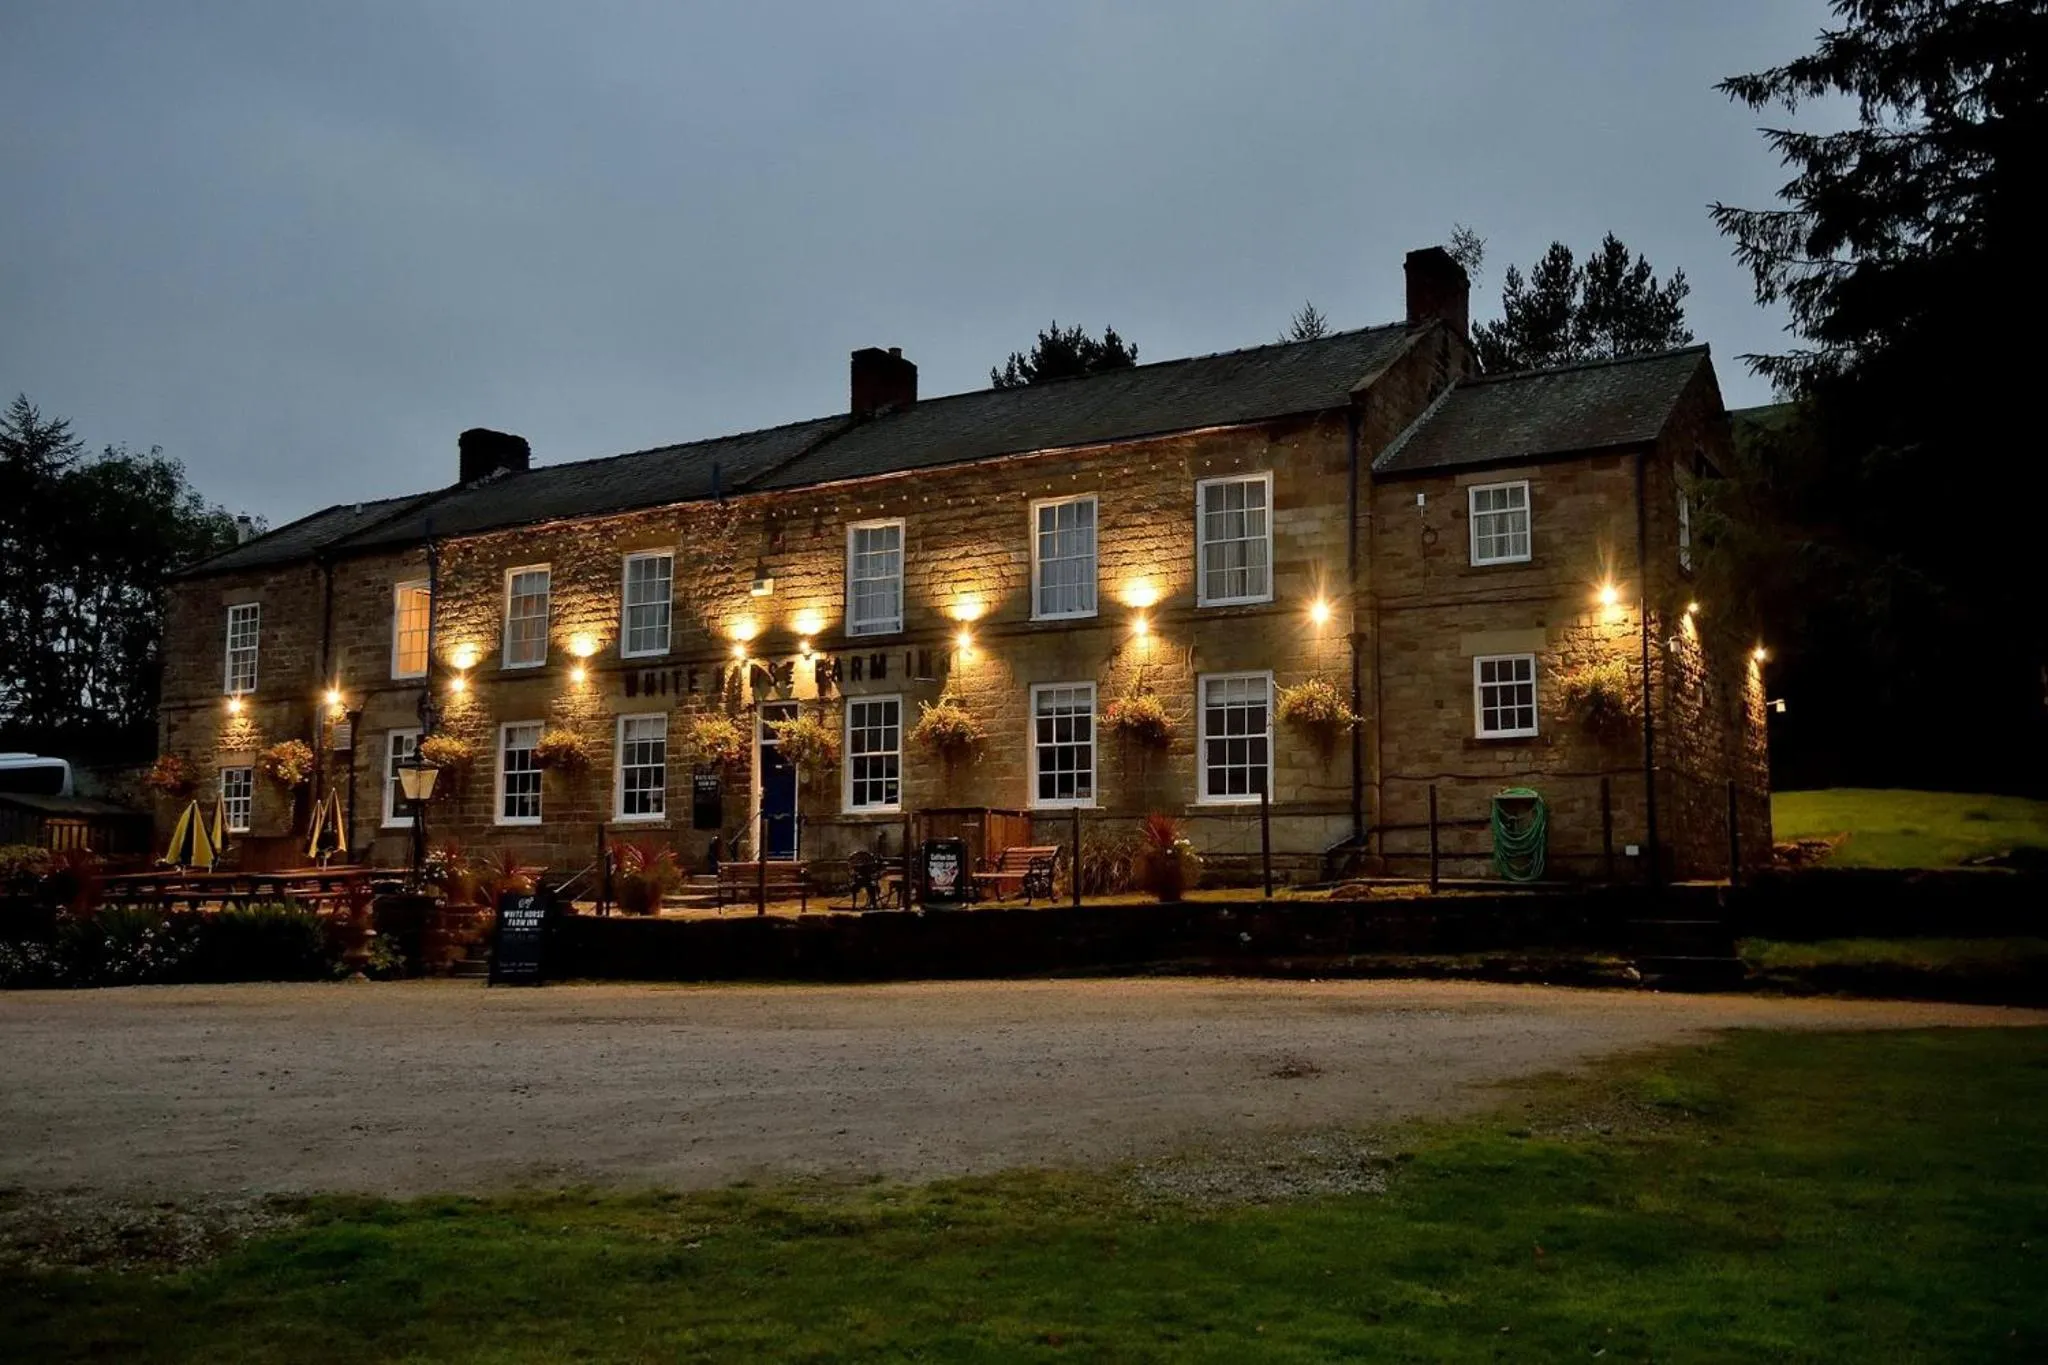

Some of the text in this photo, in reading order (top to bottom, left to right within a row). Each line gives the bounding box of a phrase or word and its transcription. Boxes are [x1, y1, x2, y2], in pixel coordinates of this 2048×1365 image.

[625, 669, 698, 697] WHITE
[715, 661, 795, 692] HRSE
[815, 652, 888, 683] FARM
[504, 910, 523, 918] WHITE
[508, 918, 526, 926] FARM
